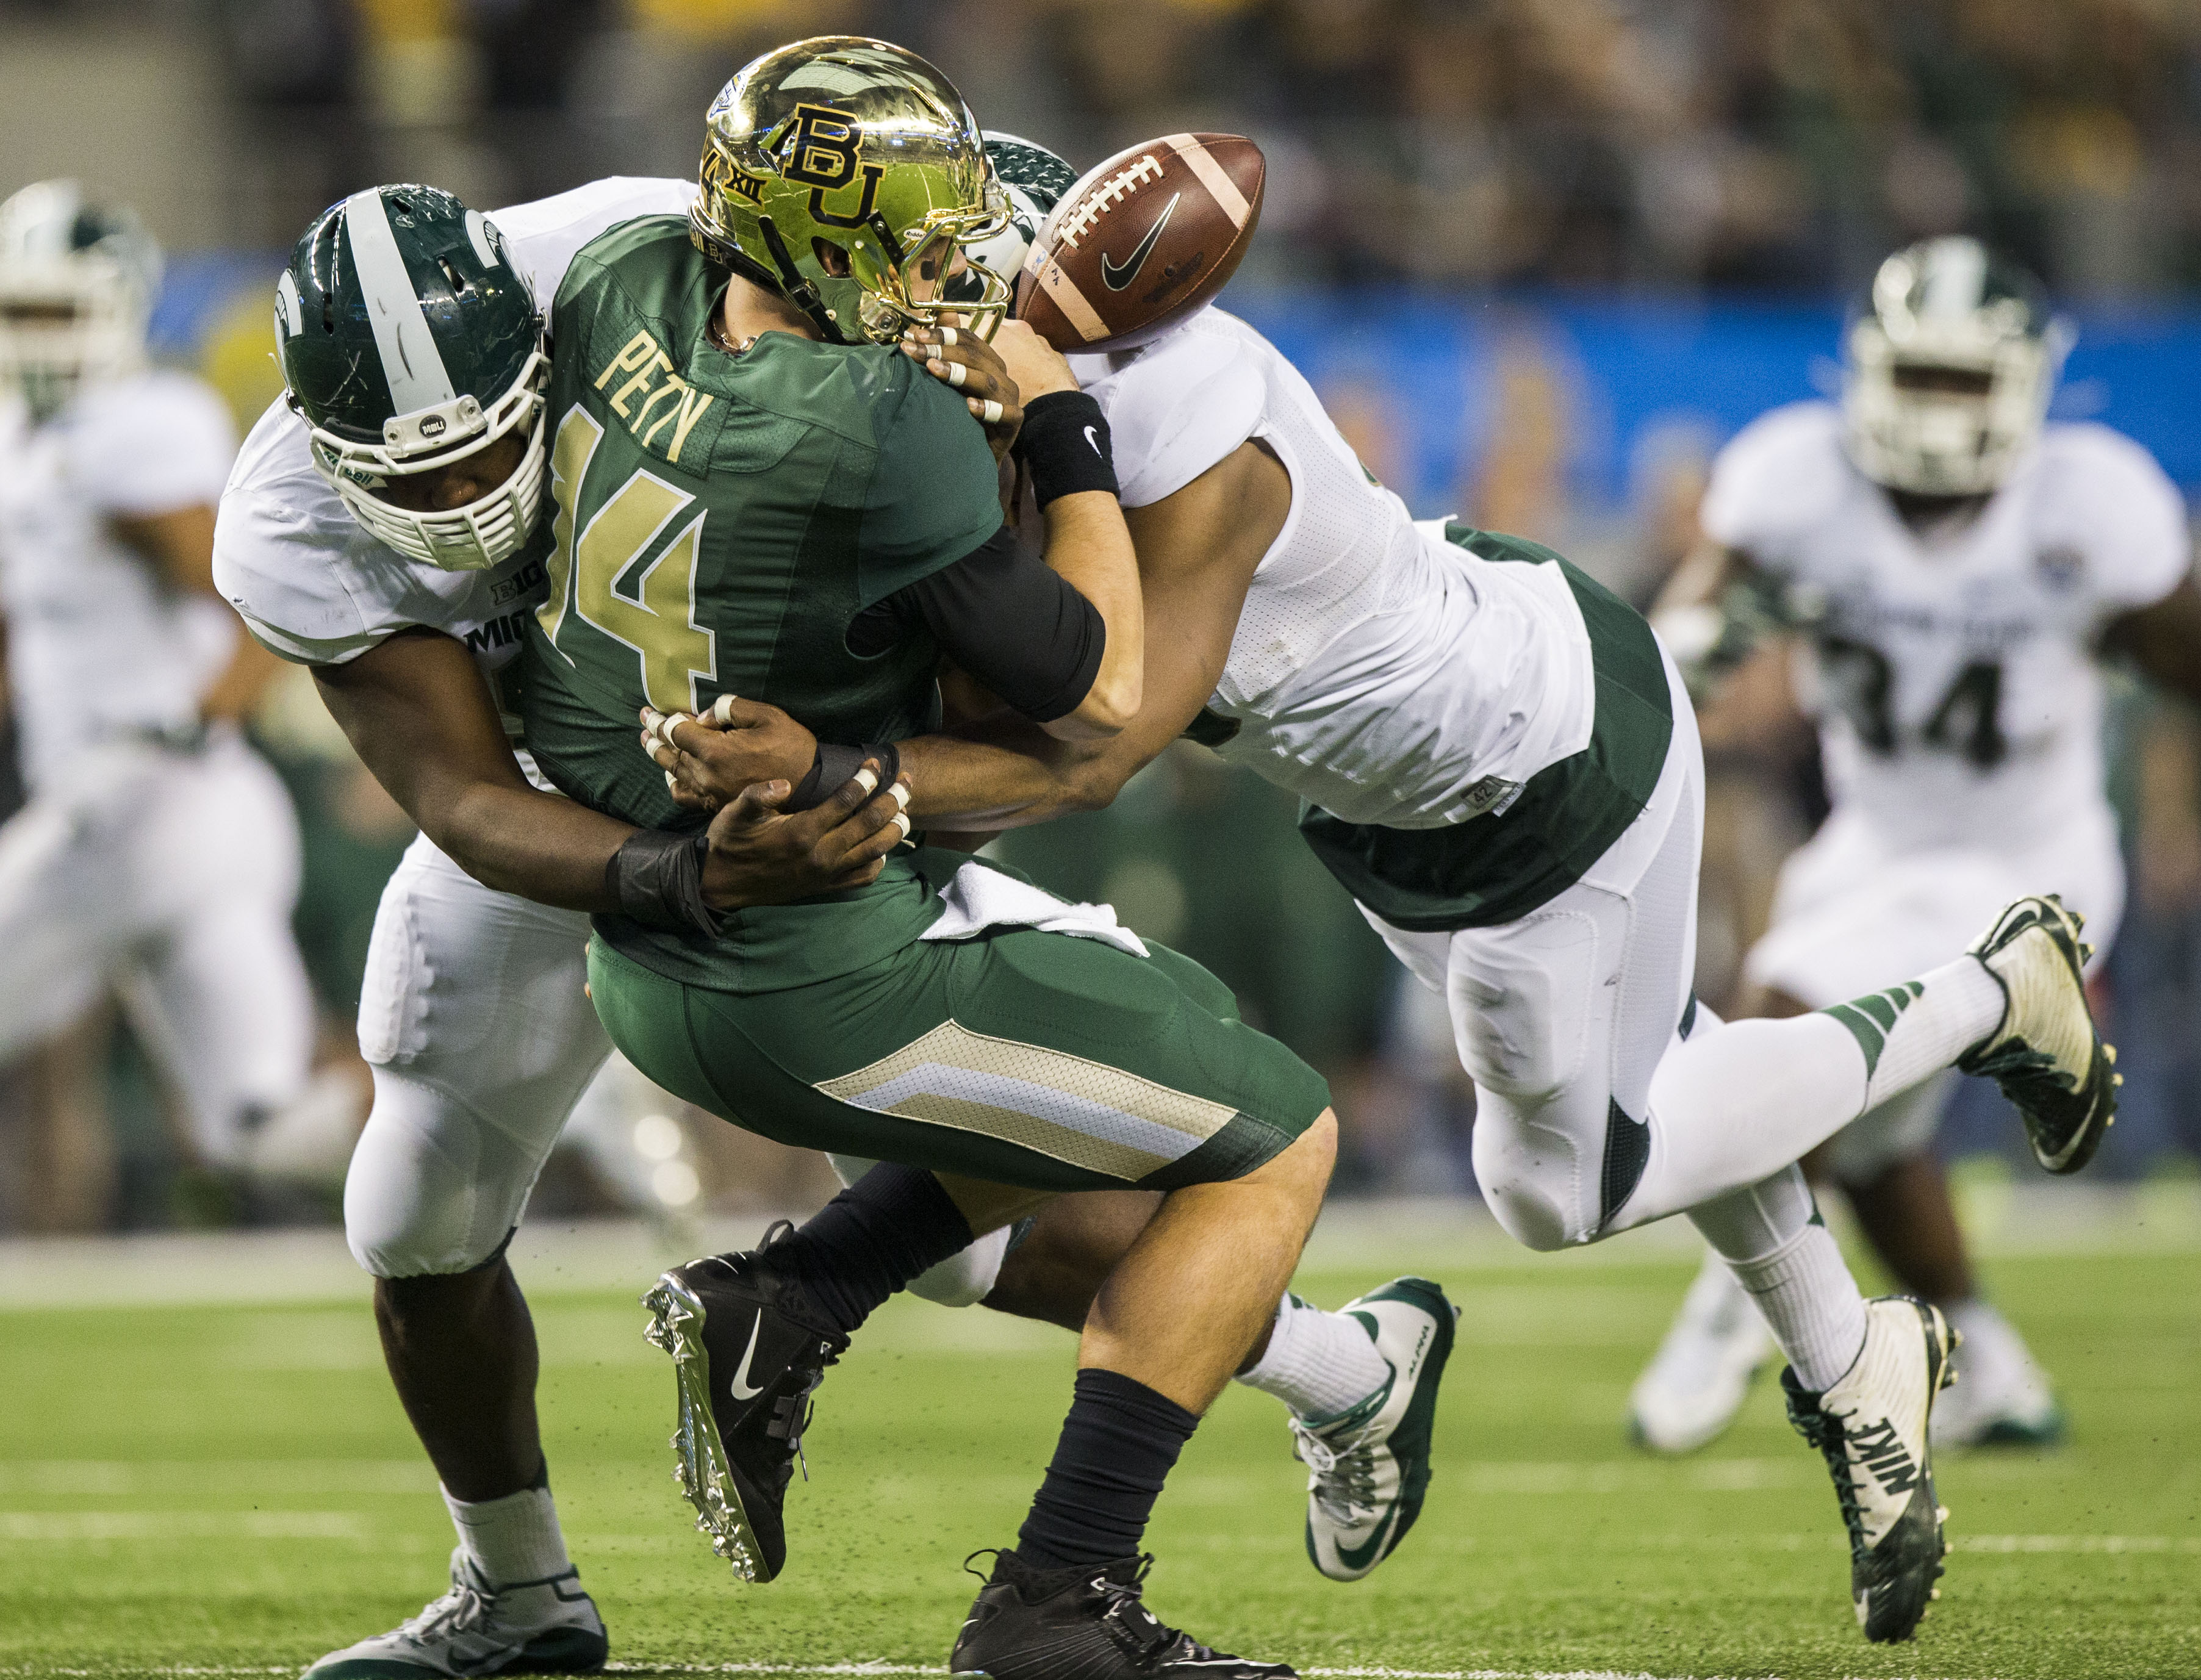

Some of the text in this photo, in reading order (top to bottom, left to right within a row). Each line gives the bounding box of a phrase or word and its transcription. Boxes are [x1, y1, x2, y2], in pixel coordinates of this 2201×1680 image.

[781, 102, 886, 231] BU
[535, 402, 717, 718] 14
[1845, 1416, 1920, 1496] NIKE
